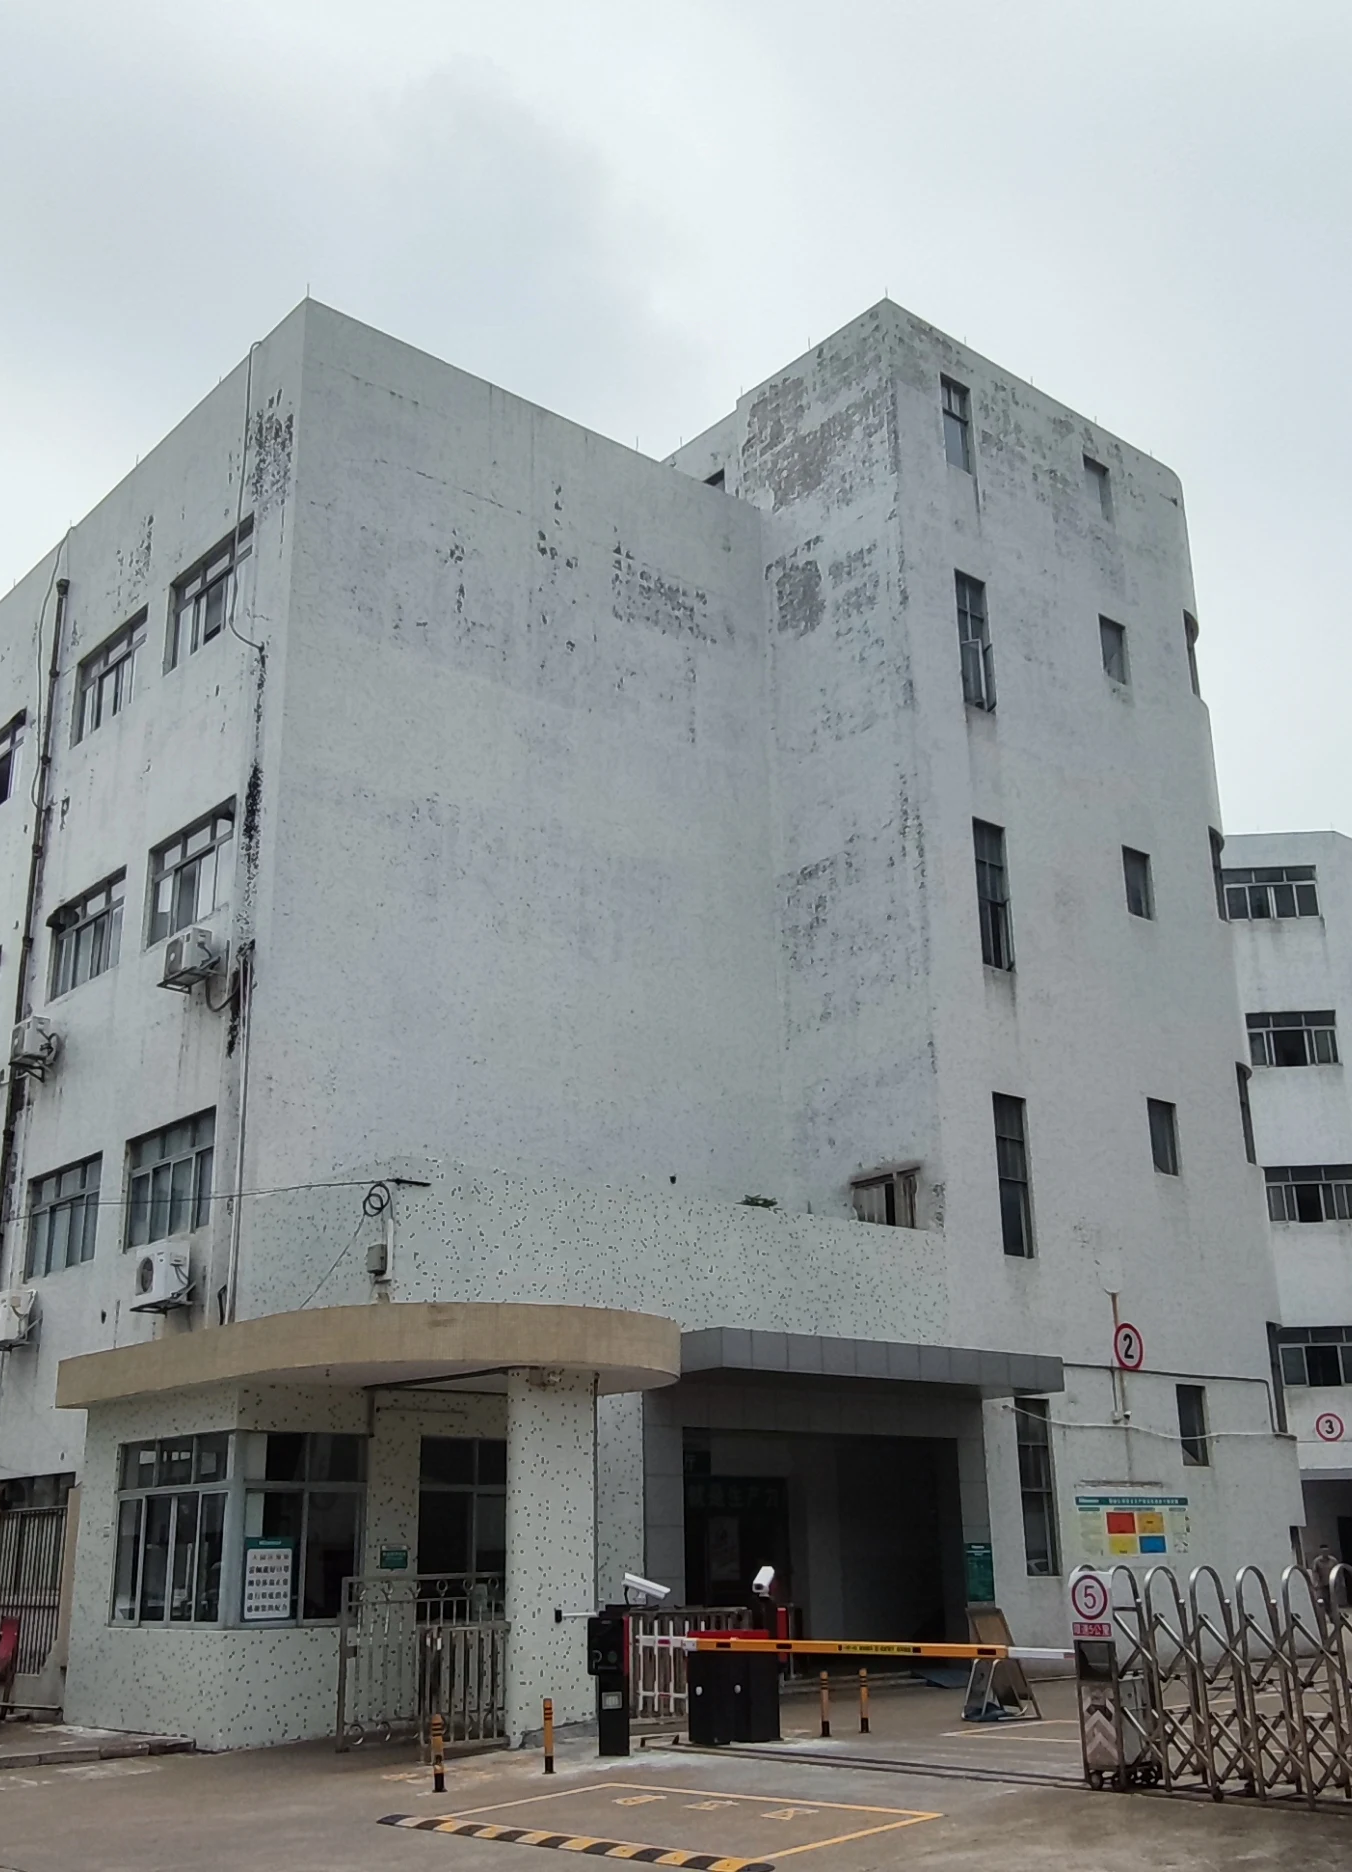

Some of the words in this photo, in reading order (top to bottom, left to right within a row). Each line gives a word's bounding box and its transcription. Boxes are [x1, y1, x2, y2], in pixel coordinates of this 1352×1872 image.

[1123, 1333, 1135, 1360] 2
[1324, 1419, 1336, 1435] 3
[1083, 1585, 1097, 1610] 5
